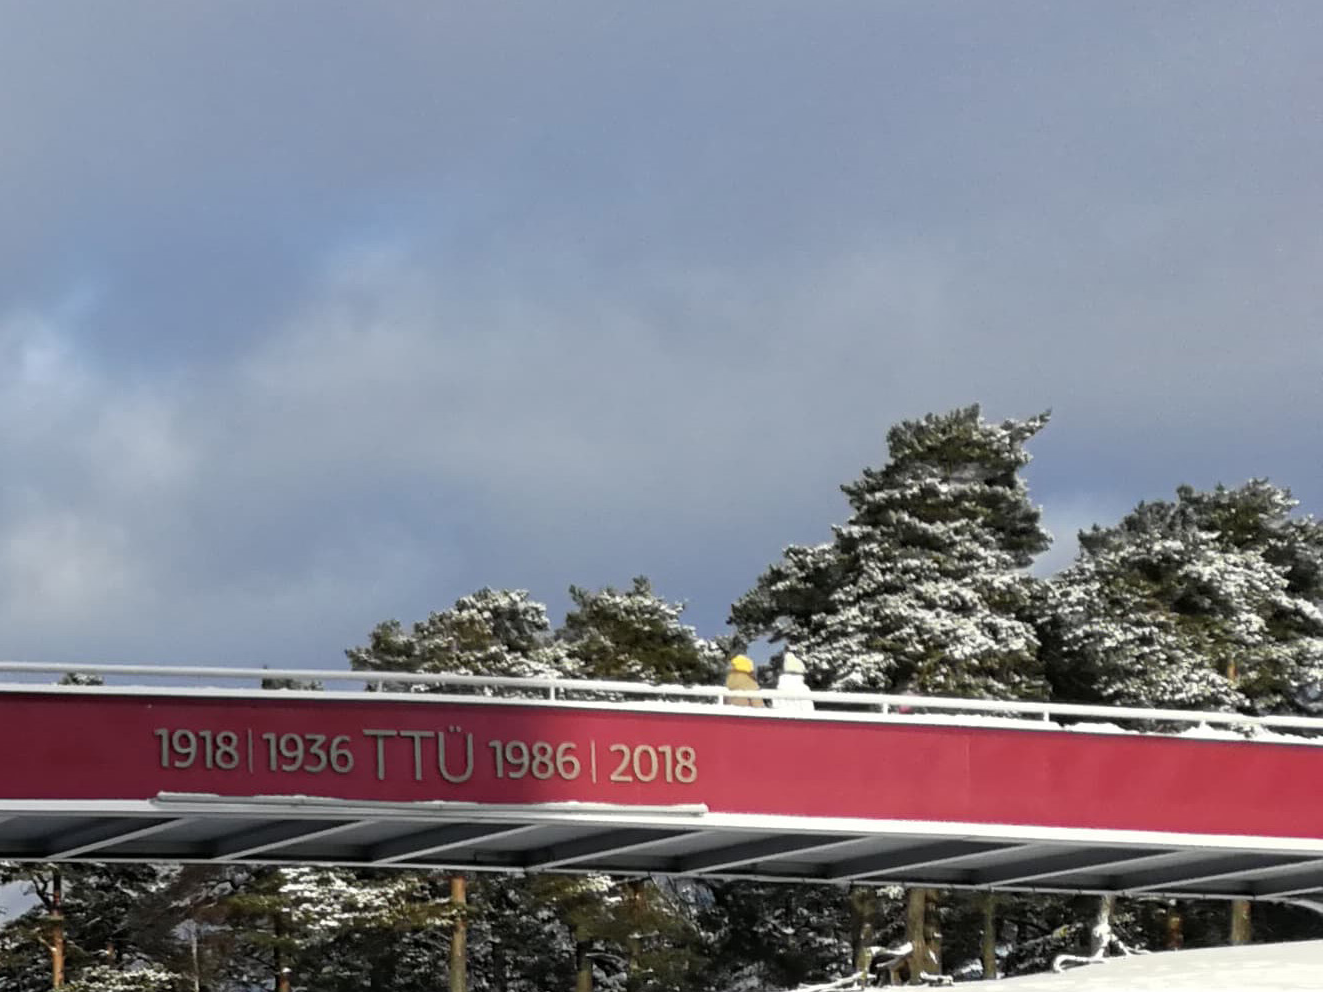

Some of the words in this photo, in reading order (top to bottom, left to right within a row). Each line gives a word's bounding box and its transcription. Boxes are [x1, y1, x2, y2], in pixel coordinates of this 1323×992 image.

[154, 728, 239, 769] 1918
[261, 732, 354, 773] 1936
[363, 725, 474, 783] TTÜ
[488, 739, 581, 780] 1986
[609, 743, 698, 783] 2018
